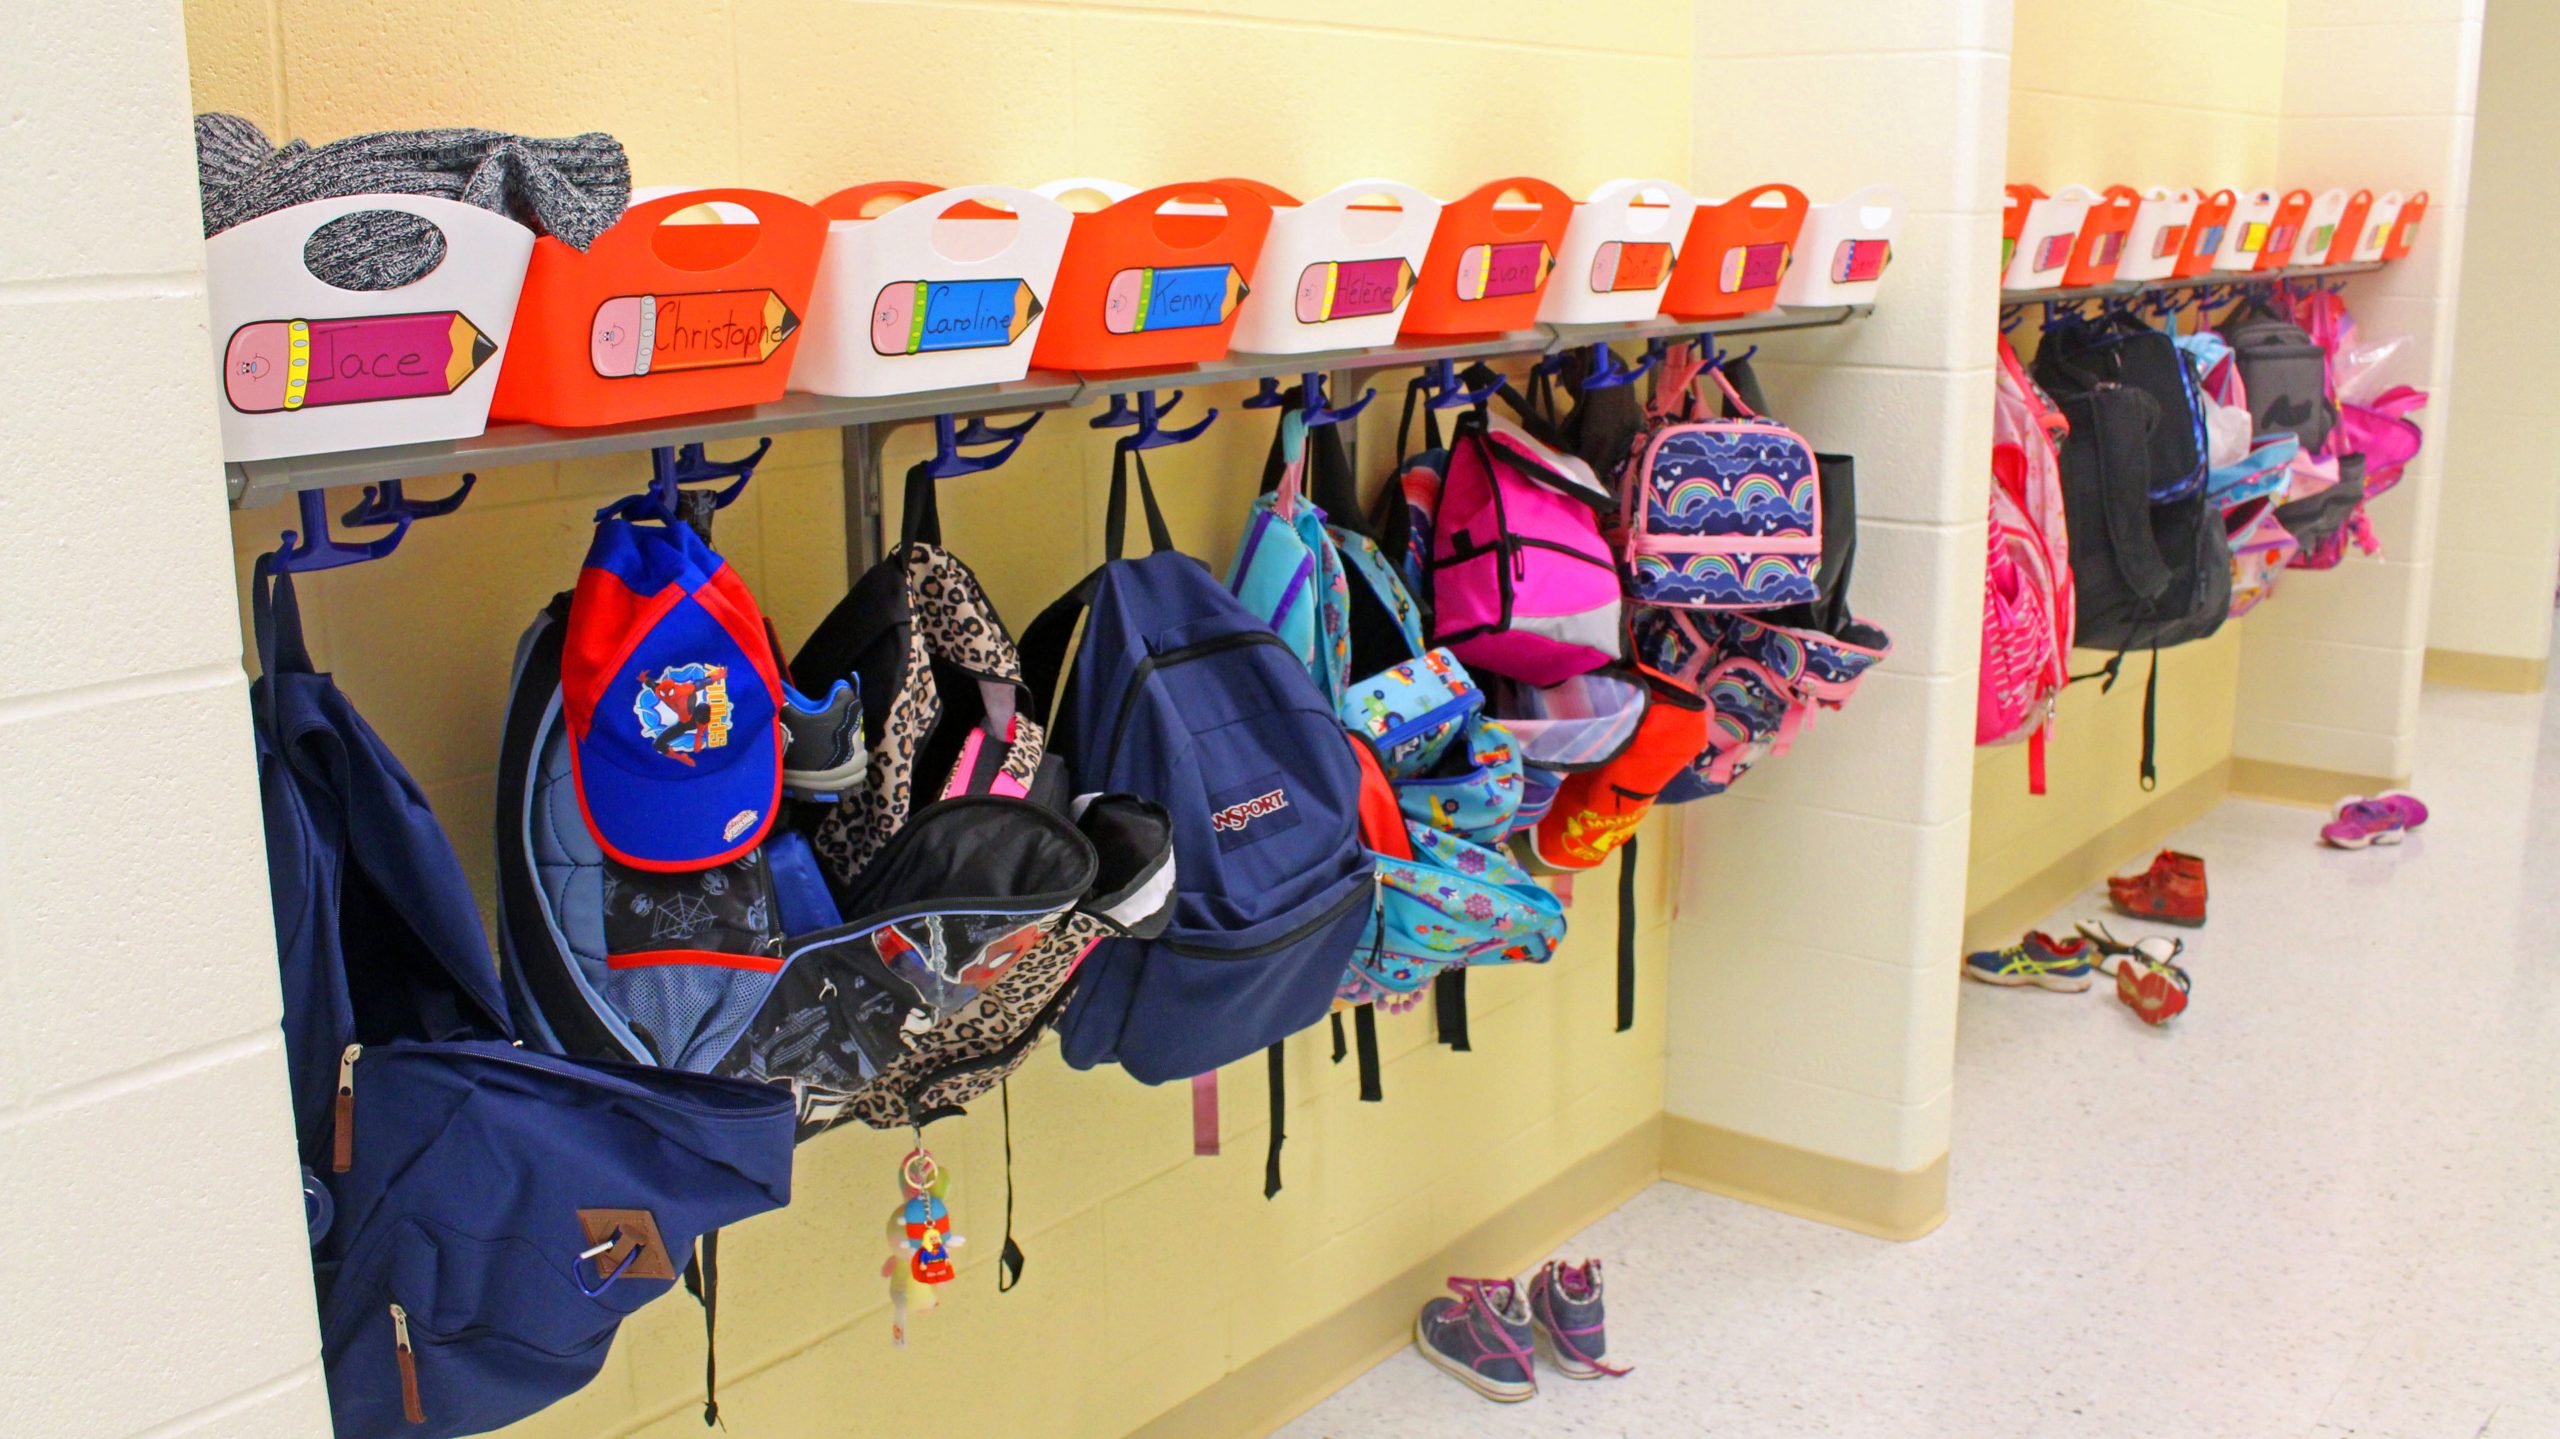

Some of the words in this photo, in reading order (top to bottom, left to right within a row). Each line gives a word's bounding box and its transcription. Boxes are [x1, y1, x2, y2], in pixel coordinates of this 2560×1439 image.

[926, 285, 1011, 334] Caroline
[1152, 273, 1218, 325] Kenny
[1338, 269, 1393, 305] Hélène
[308, 325, 429, 382] Jace
[655, 300, 783, 358] Christophe
